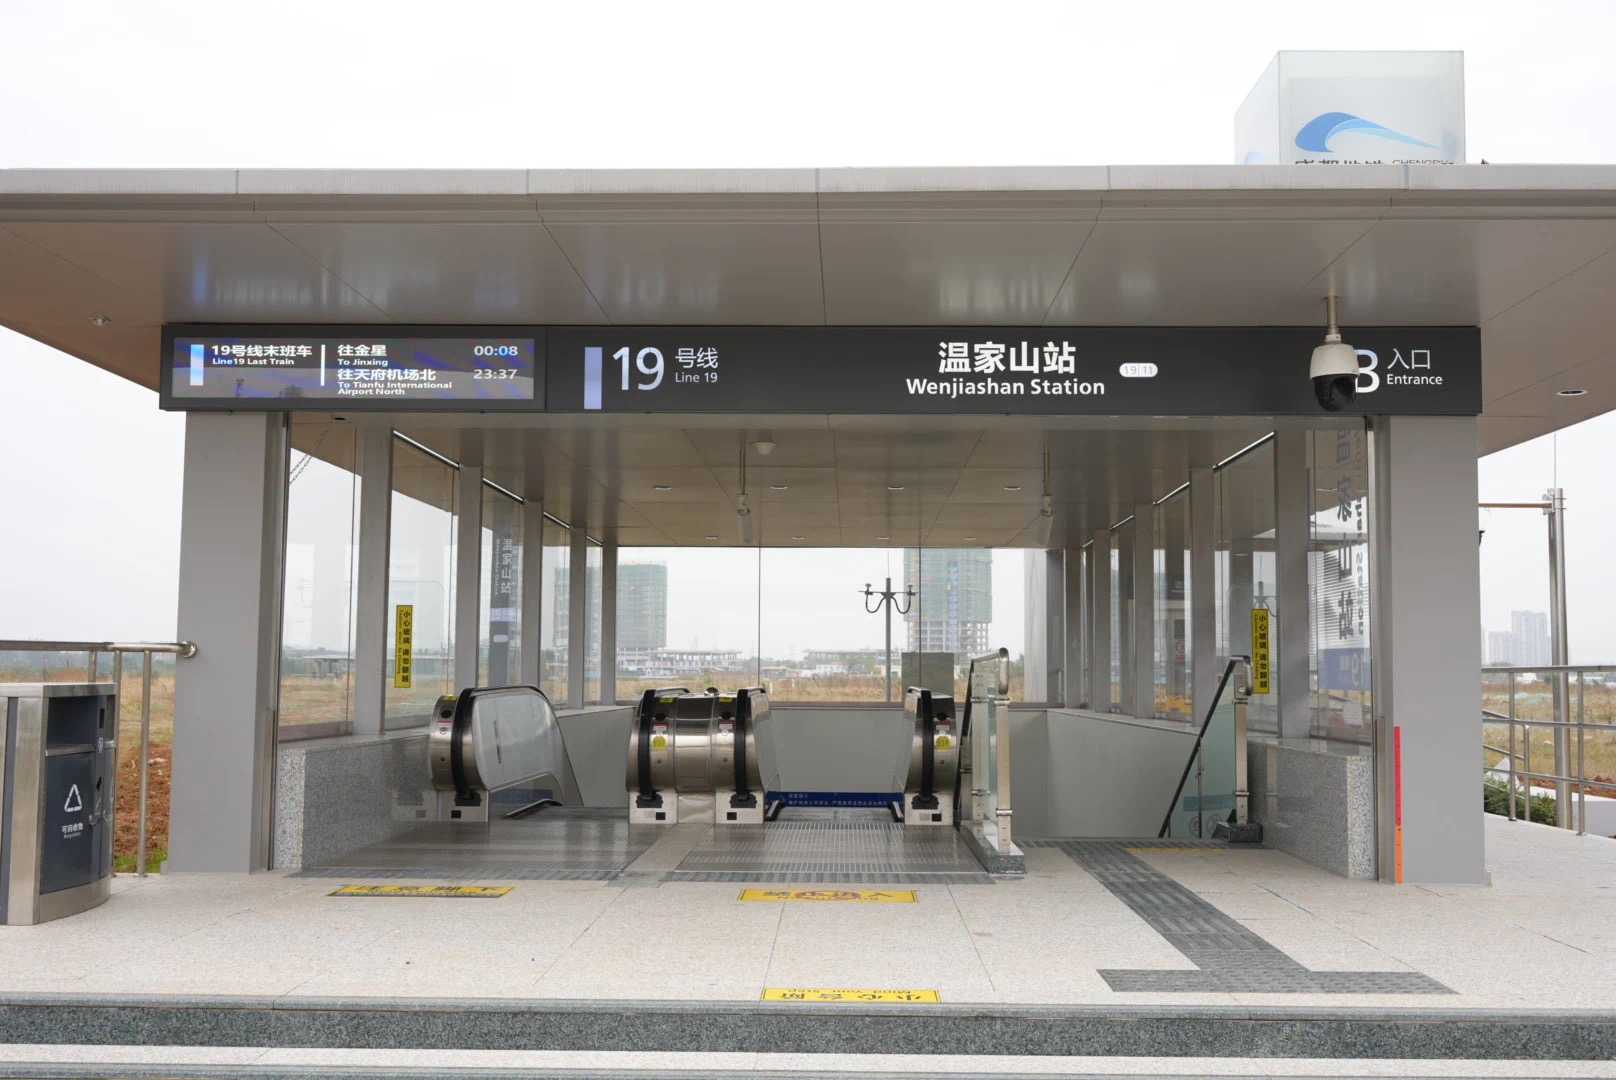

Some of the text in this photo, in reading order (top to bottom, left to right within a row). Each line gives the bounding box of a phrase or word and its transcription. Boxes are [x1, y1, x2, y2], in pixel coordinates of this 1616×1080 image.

[212, 345, 312, 357] 19号线末班车
[337, 344, 387, 356] 往金星
[474, 346, 518, 356] 00:08
[337, 358, 388, 366] To Jinxing
[675, 347, 719, 369] 号线
[938, 341, 1076, 374] 温家山站
[1387, 348, 1431, 369] 入口
[337, 369, 436, 381] 往天府机场北
[473, 369, 518, 379] 23:37
[612, 347, 665, 391] 19
[675, 372, 718, 383] Line 19
[1387, 374, 1443, 385] Entrance
[338, 388, 405, 397] Airport North
[906, 378, 1105, 398] Wenjiashan Station
[501, 538, 512, 594] 温家山站
